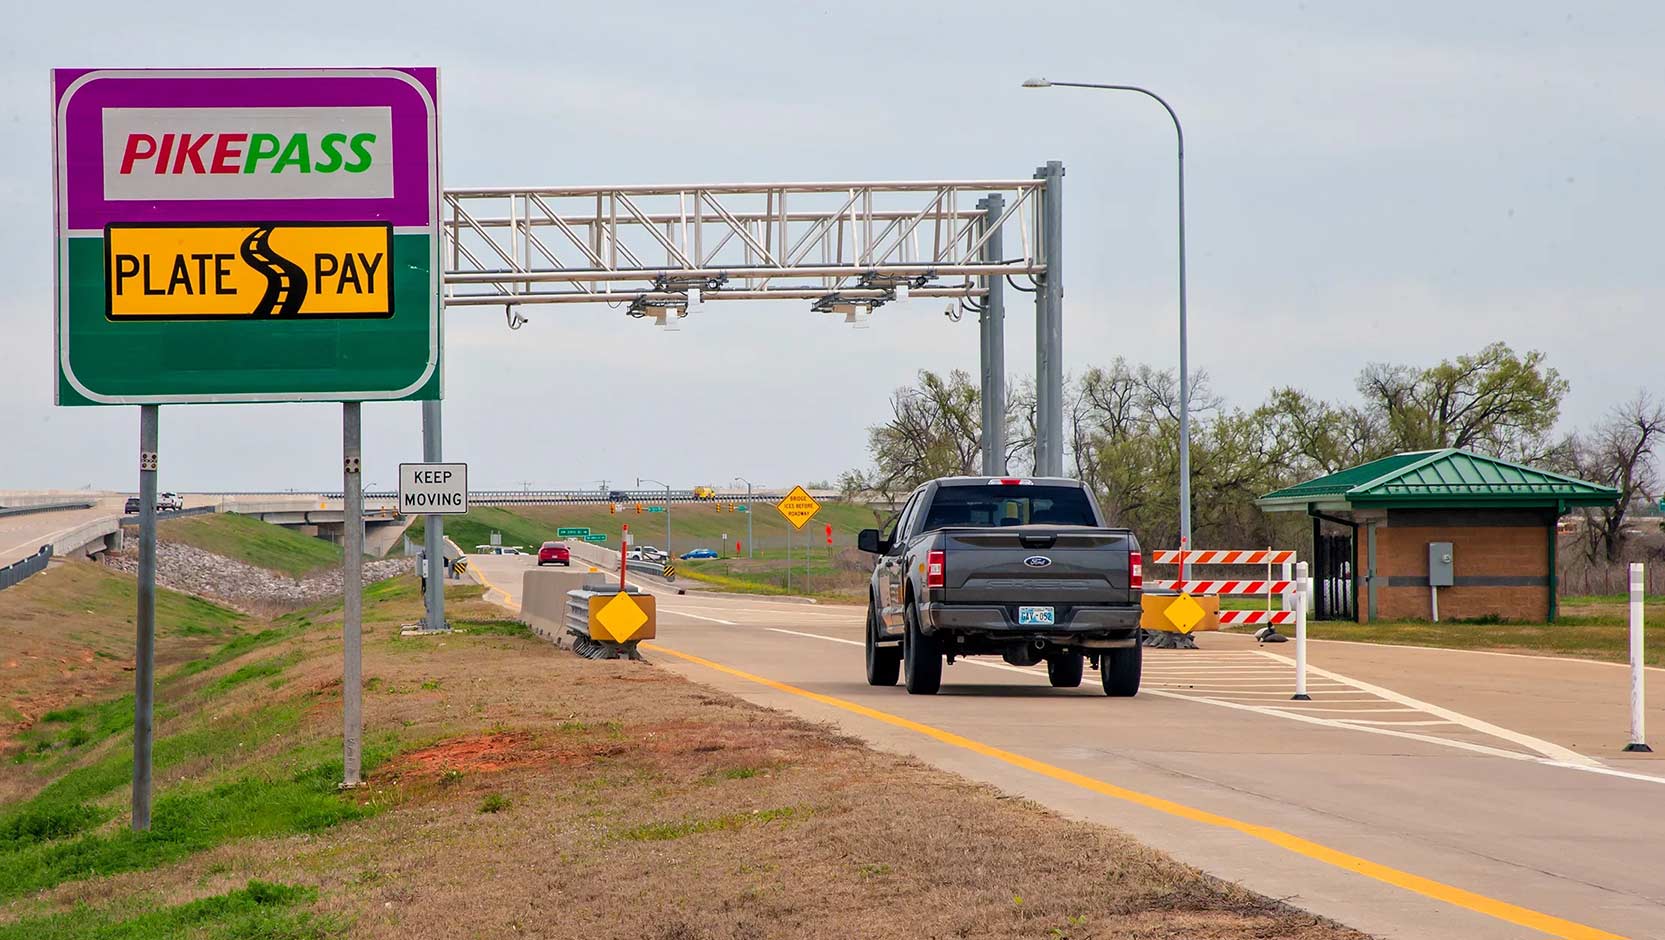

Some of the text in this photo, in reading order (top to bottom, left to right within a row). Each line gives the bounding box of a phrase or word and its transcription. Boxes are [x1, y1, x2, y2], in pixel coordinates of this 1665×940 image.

[120, 133, 376, 175] PIKEPASS
[116, 252, 384, 295] PLATE PAY
[414, 471, 452, 484] KEEP
[405, 493, 462, 506] MOVING
